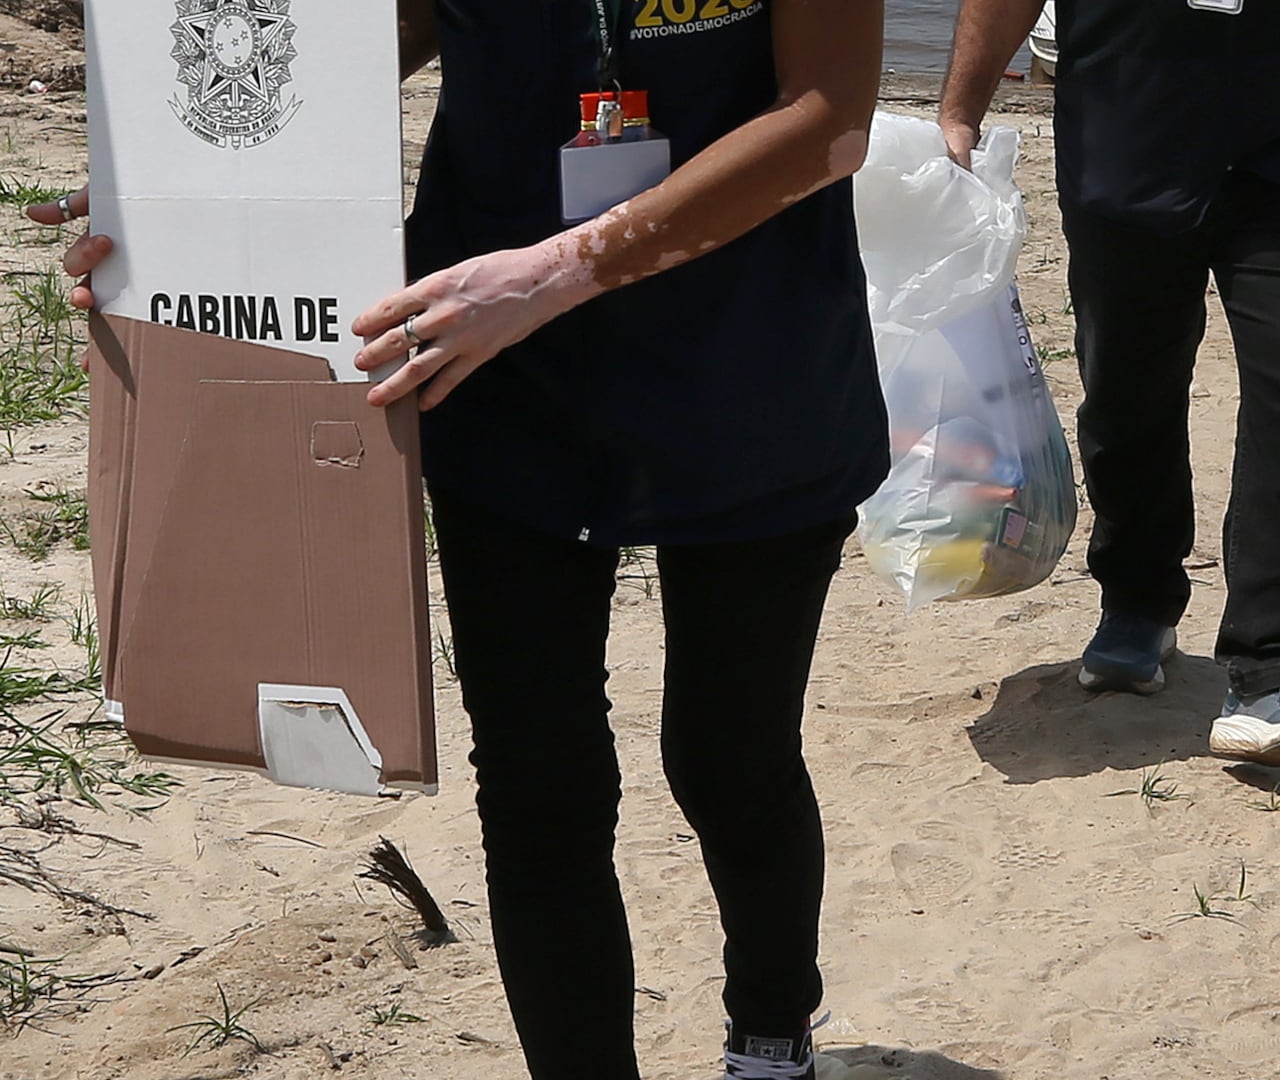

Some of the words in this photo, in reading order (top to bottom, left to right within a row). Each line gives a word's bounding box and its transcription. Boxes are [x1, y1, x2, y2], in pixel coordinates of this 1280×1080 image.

[600, 17, 607, 28] DA
[629, 1, 763, 39] #VOTONADEMOCRACIA
[150, 292, 283, 340] CABINA
[293, 296, 339, 342] DE
